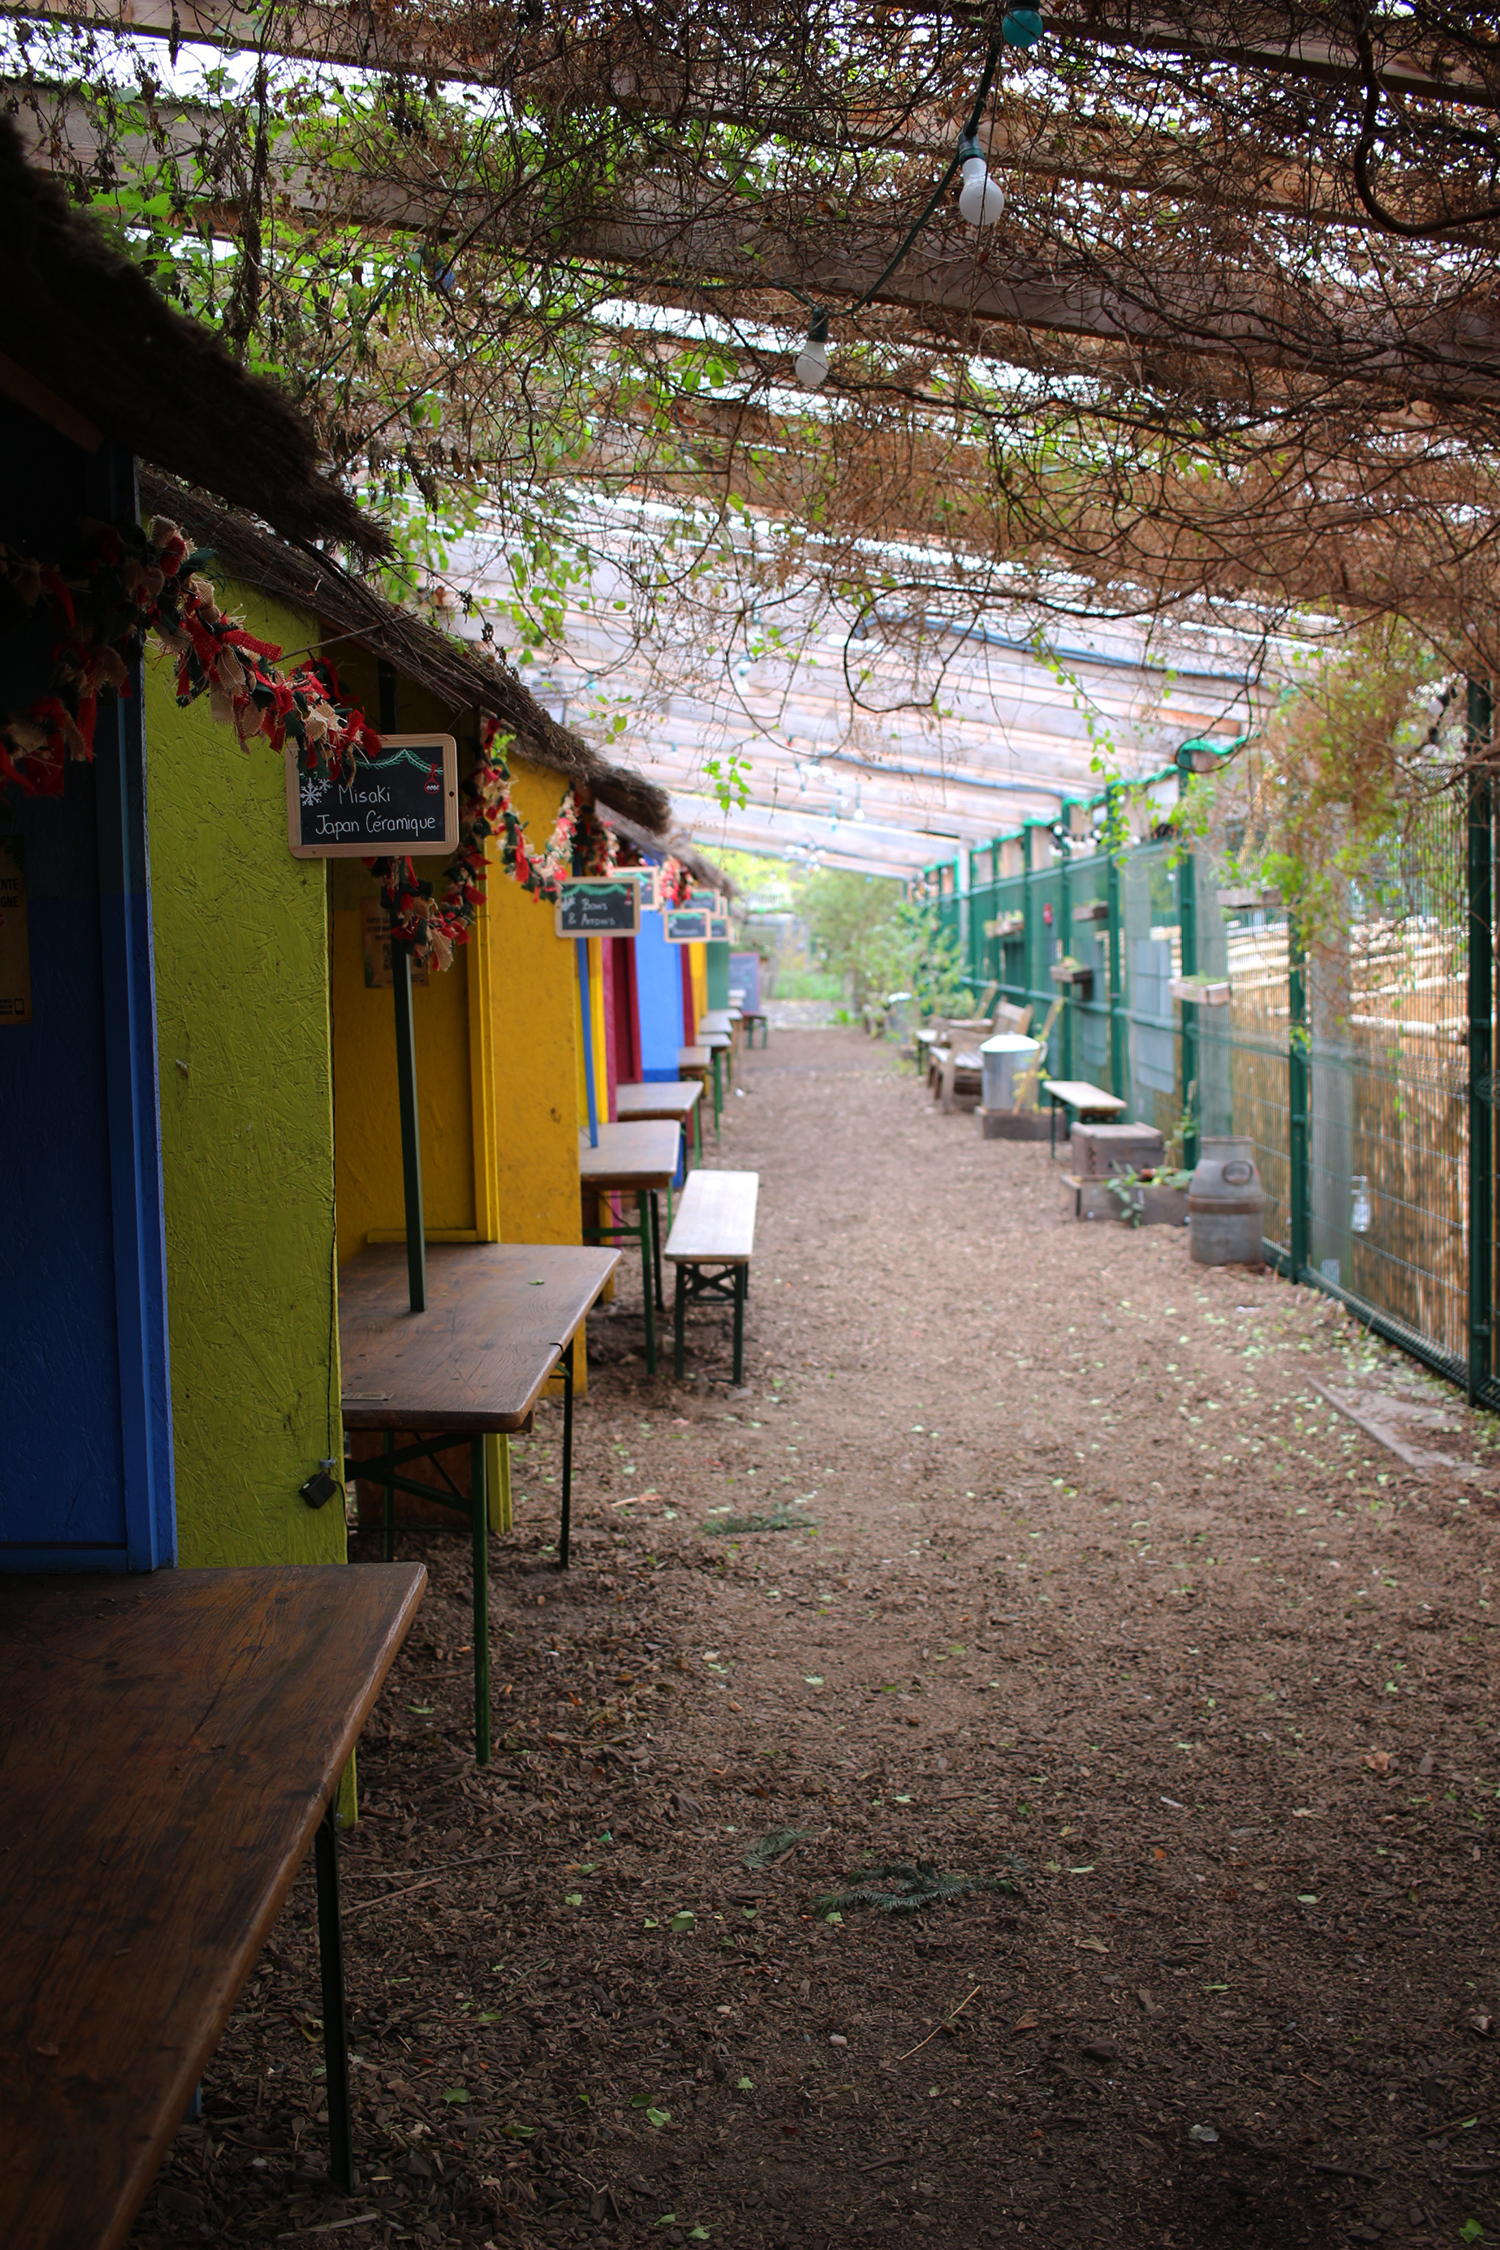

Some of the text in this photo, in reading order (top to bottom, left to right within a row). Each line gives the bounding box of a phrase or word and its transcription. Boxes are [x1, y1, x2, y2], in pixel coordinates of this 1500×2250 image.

[337, 784, 390, 804] Misaki
[315, 809, 436, 840] Japan Céramique
[0, 878, 18, 891] NTE
[581, 898, 608, 911] Bows
[568, 912, 616, 926] & Arrows
